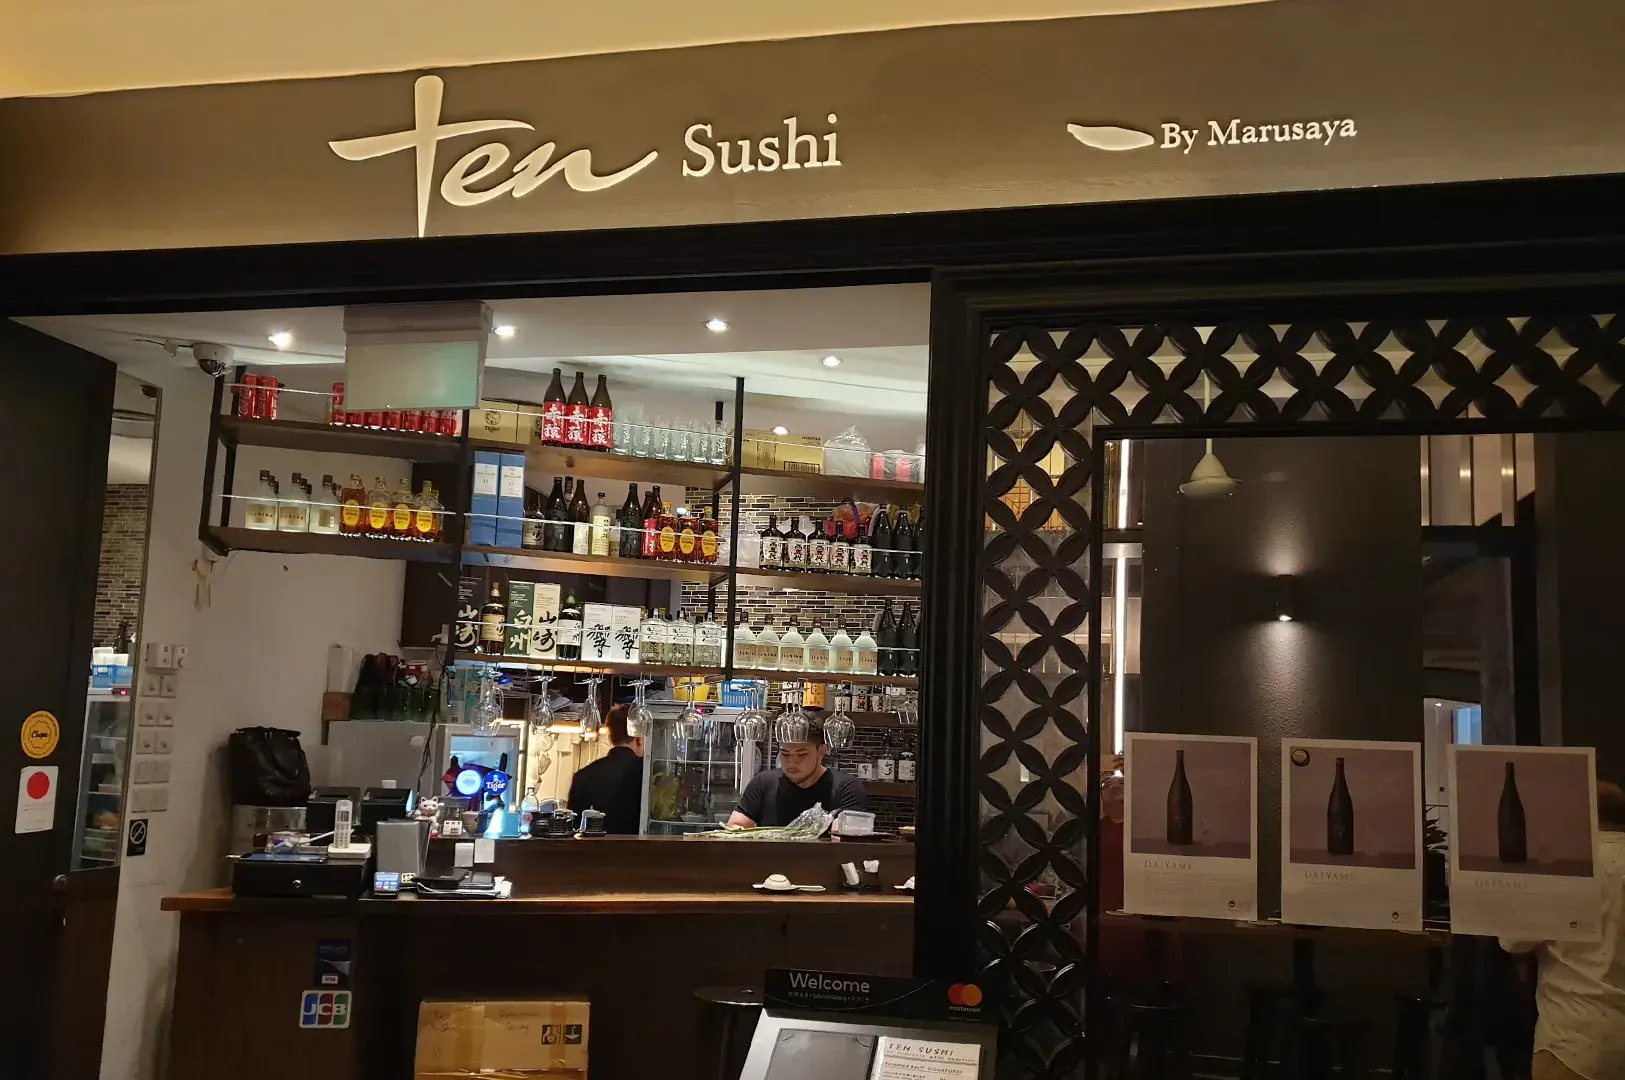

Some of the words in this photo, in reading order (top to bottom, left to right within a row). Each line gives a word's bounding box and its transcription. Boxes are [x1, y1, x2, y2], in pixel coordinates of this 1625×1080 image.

[1160, 122, 1198, 154] By
[1207, 118, 1358, 146] Marusaya
[328, 75, 658, 238] Ten
[682, 113, 842, 178] Sushi
[486, 780, 506, 792] Tiger
[1144, 859, 1193, 871] DAIYAME
[1304, 871, 1352, 881] DAIYAM
[789, 972, 870, 993] Welcome
[302, 1003, 347, 1016] JCB
[949, 1005, 981, 1013] mastercard
[889, 1043, 911, 1052] TEN
[918, 1047, 954, 1056] SUSHI
